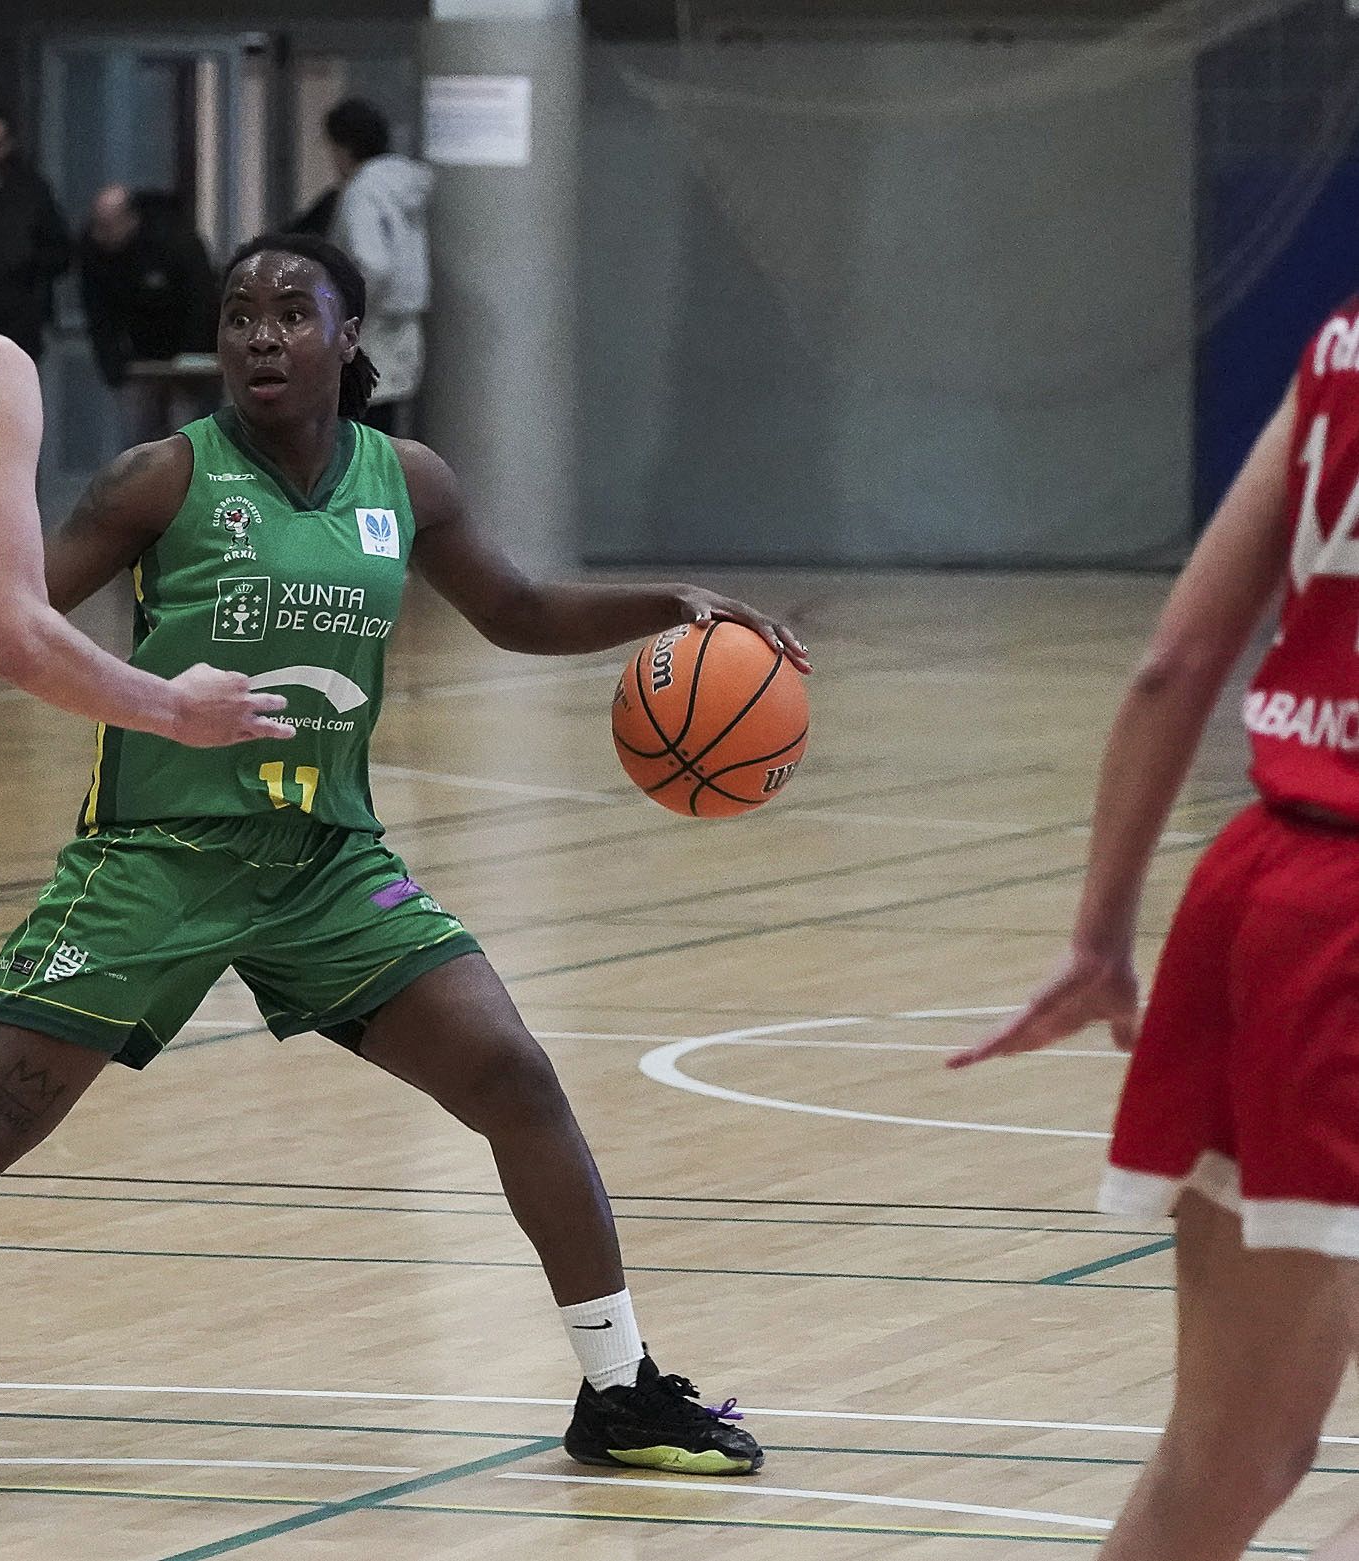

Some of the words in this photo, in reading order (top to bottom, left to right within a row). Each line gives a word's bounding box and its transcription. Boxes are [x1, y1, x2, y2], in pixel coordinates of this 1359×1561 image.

[212, 507, 223, 527] CLUB
[223, 549, 257, 562] ARXIL
[280, 583, 365, 610] XUNTA
[275, 609, 309, 630] DE
[1242, 690, 1359, 749] ABANC
[258, 760, 320, 814] 11
